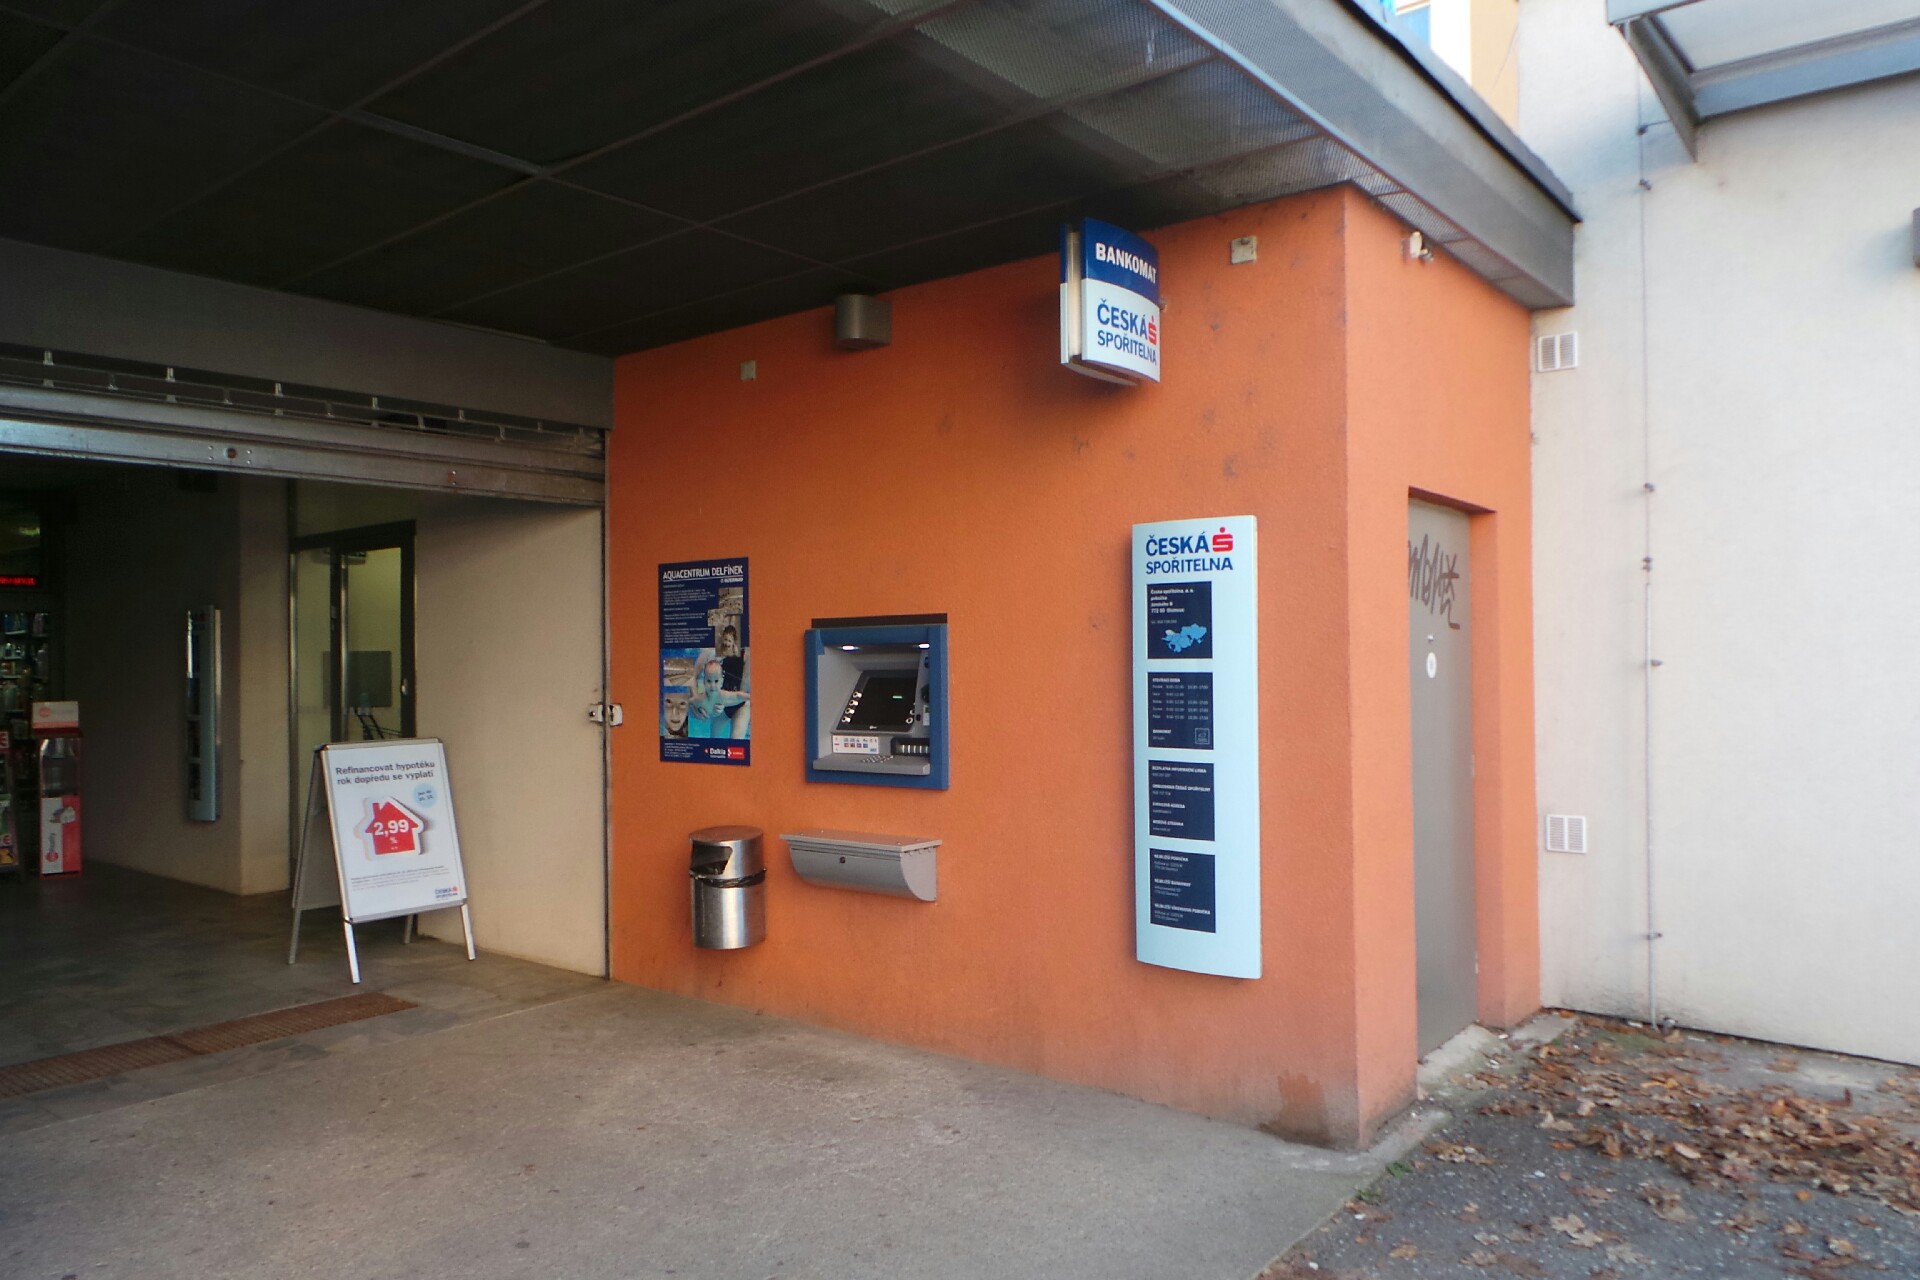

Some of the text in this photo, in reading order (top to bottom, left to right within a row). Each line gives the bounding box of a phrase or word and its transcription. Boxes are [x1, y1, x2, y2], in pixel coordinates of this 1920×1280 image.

[1095, 242, 1157, 284] BANKOMAT
[1097, 298, 1148, 340] ČESKÁ
[1097, 329, 1157, 366] SPOŘITELNA
[1145, 531, 1210, 556] ČESKÁ
[662, 568, 710, 581] AQUACENTRUM
[711, 564, 743, 577] DELFÍNEK
[1145, 556, 1233, 575] SPOŘITELNA
[335, 760, 435, 775] Refinancovat hypotéku
[337, 769, 434, 785] rok dopředu se vyplatí
[373, 819, 409, 838] 2,99
